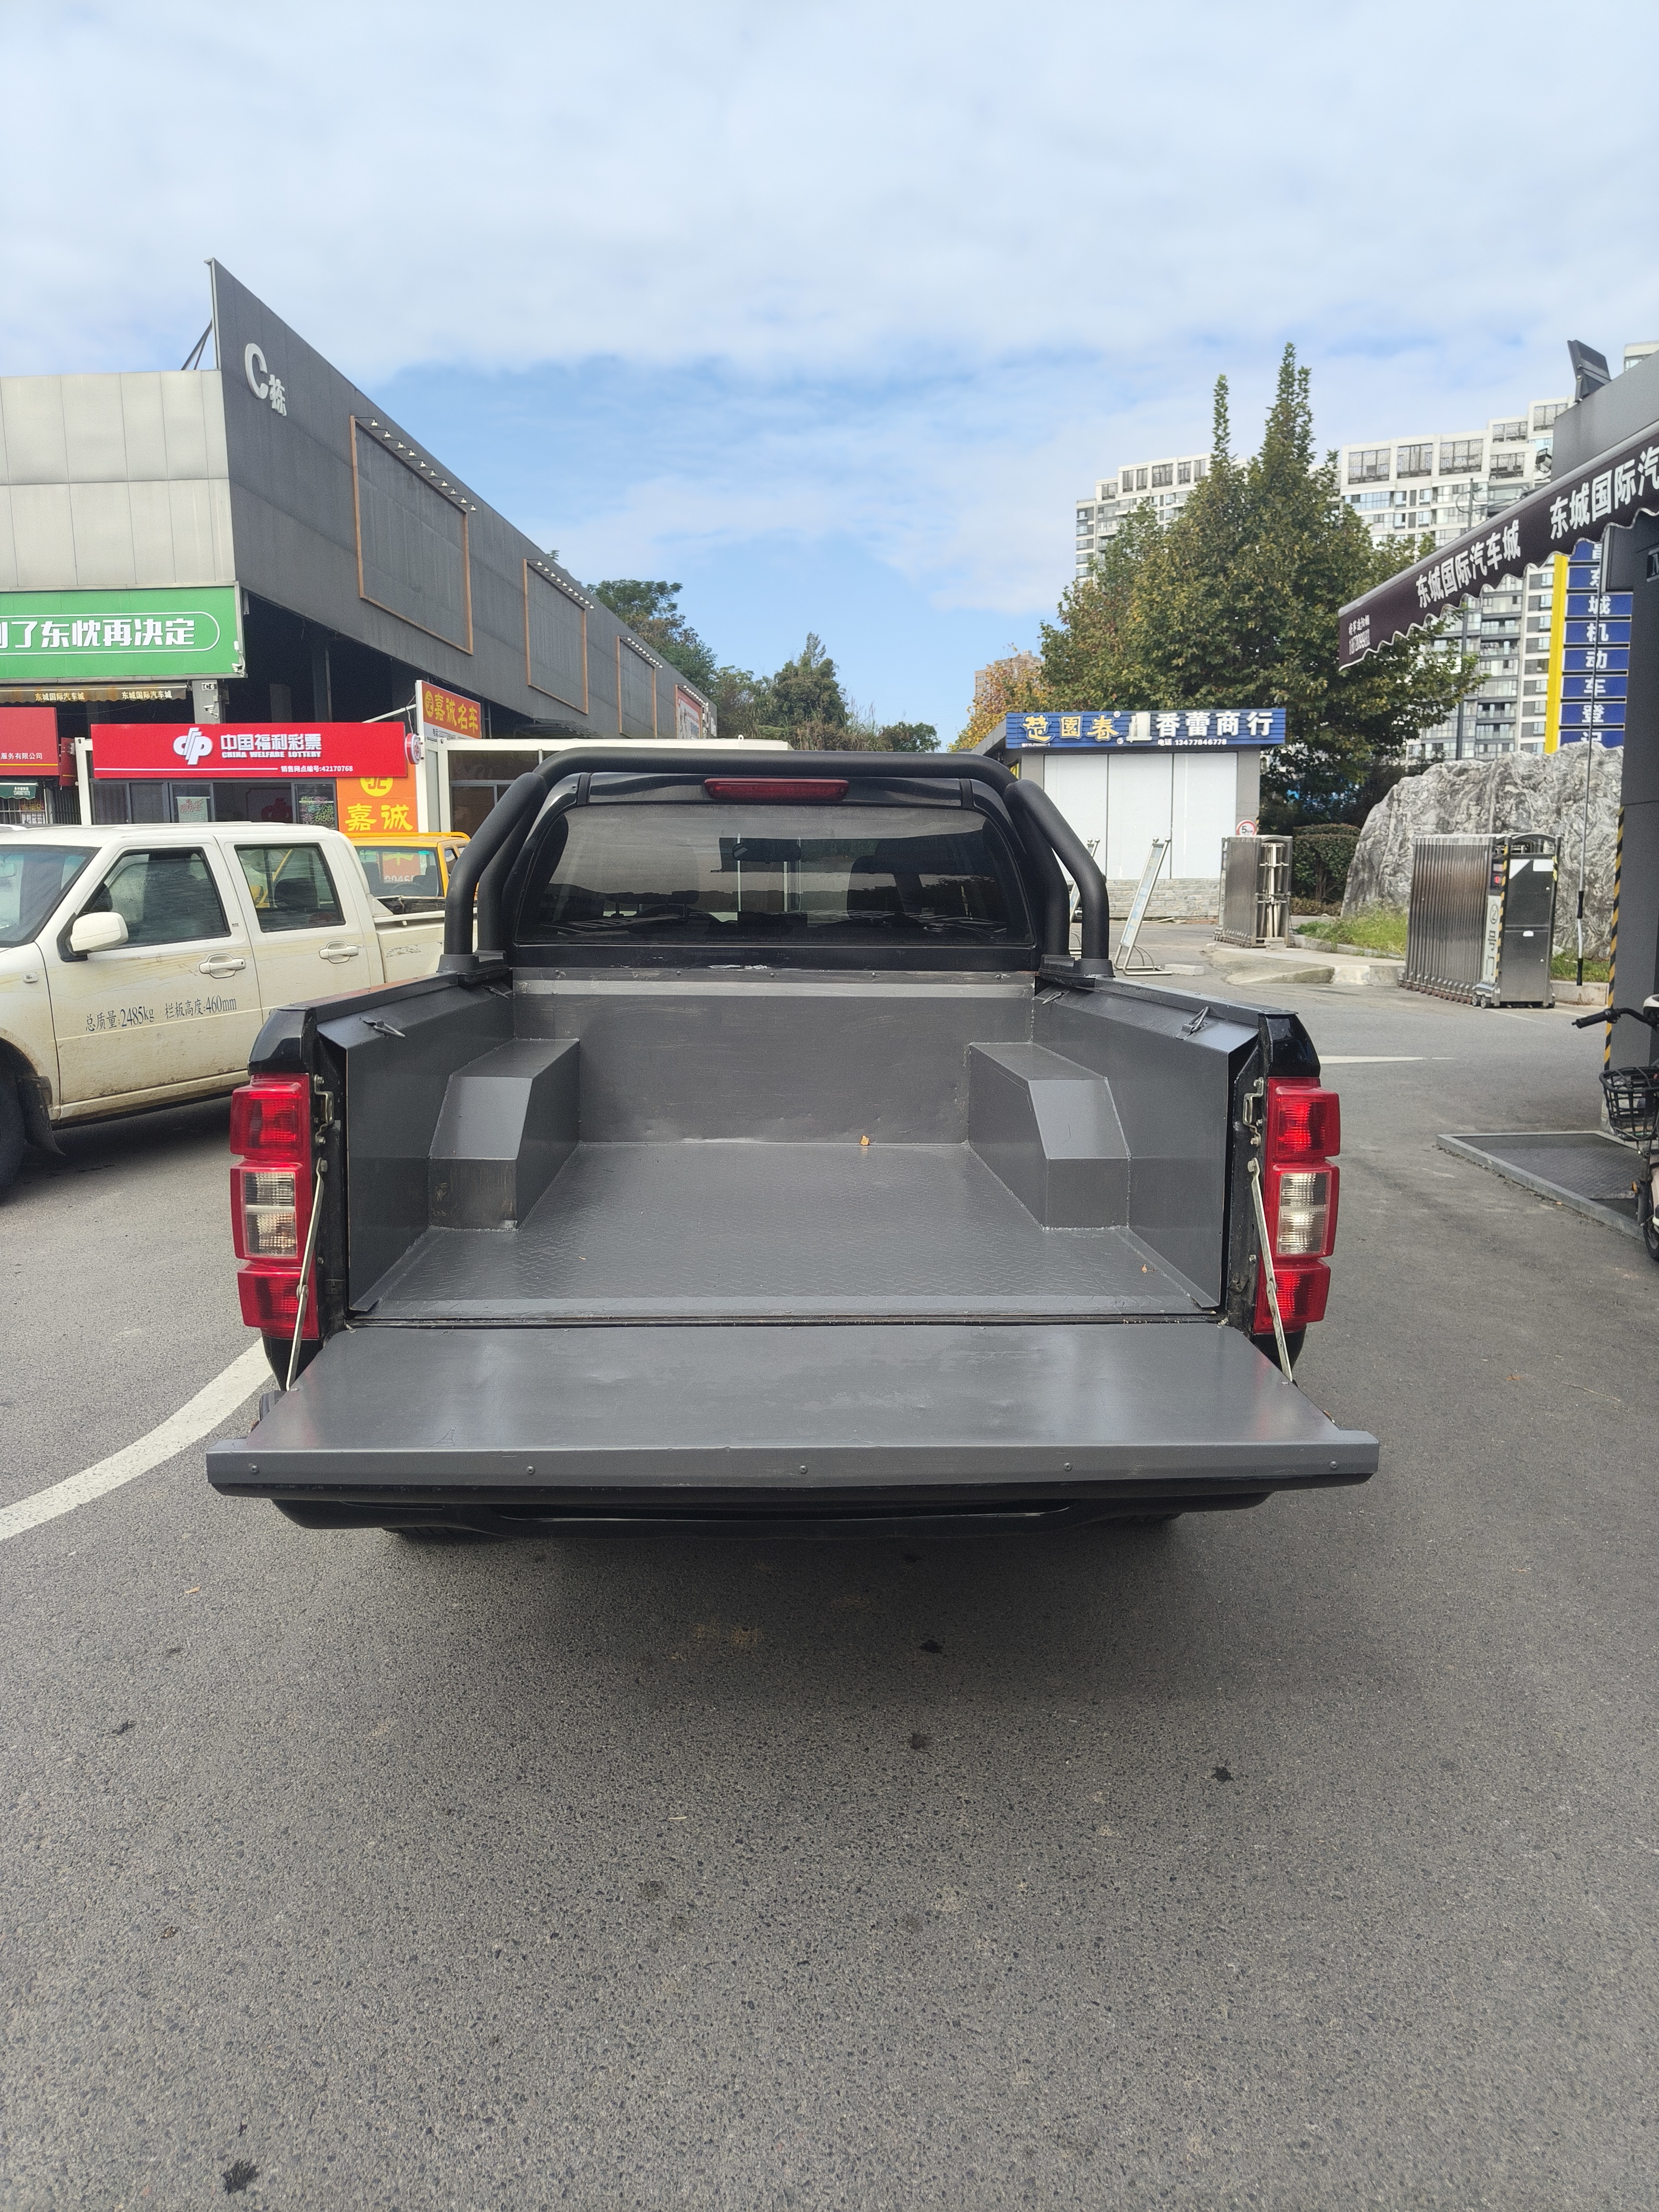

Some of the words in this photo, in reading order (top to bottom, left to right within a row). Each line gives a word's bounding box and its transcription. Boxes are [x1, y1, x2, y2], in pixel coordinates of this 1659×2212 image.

[1416, 519, 1521, 608] 东城国际汽车城
[35, 692, 85, 701] 东城国际汽车城
[122, 690, 172, 699] 东城国际汽车城
[434, 692, 478, 734] 嘉诚名车
[1156, 711, 1273, 737] 香蕾商行
[220, 733, 321, 751] 中国福利彩票
[345, 803, 414, 831] 嘉诚
[85, 1006, 155, 1031] 总质量:2485kg
[165, 995, 237, 1020] 栏板高度:460mm
